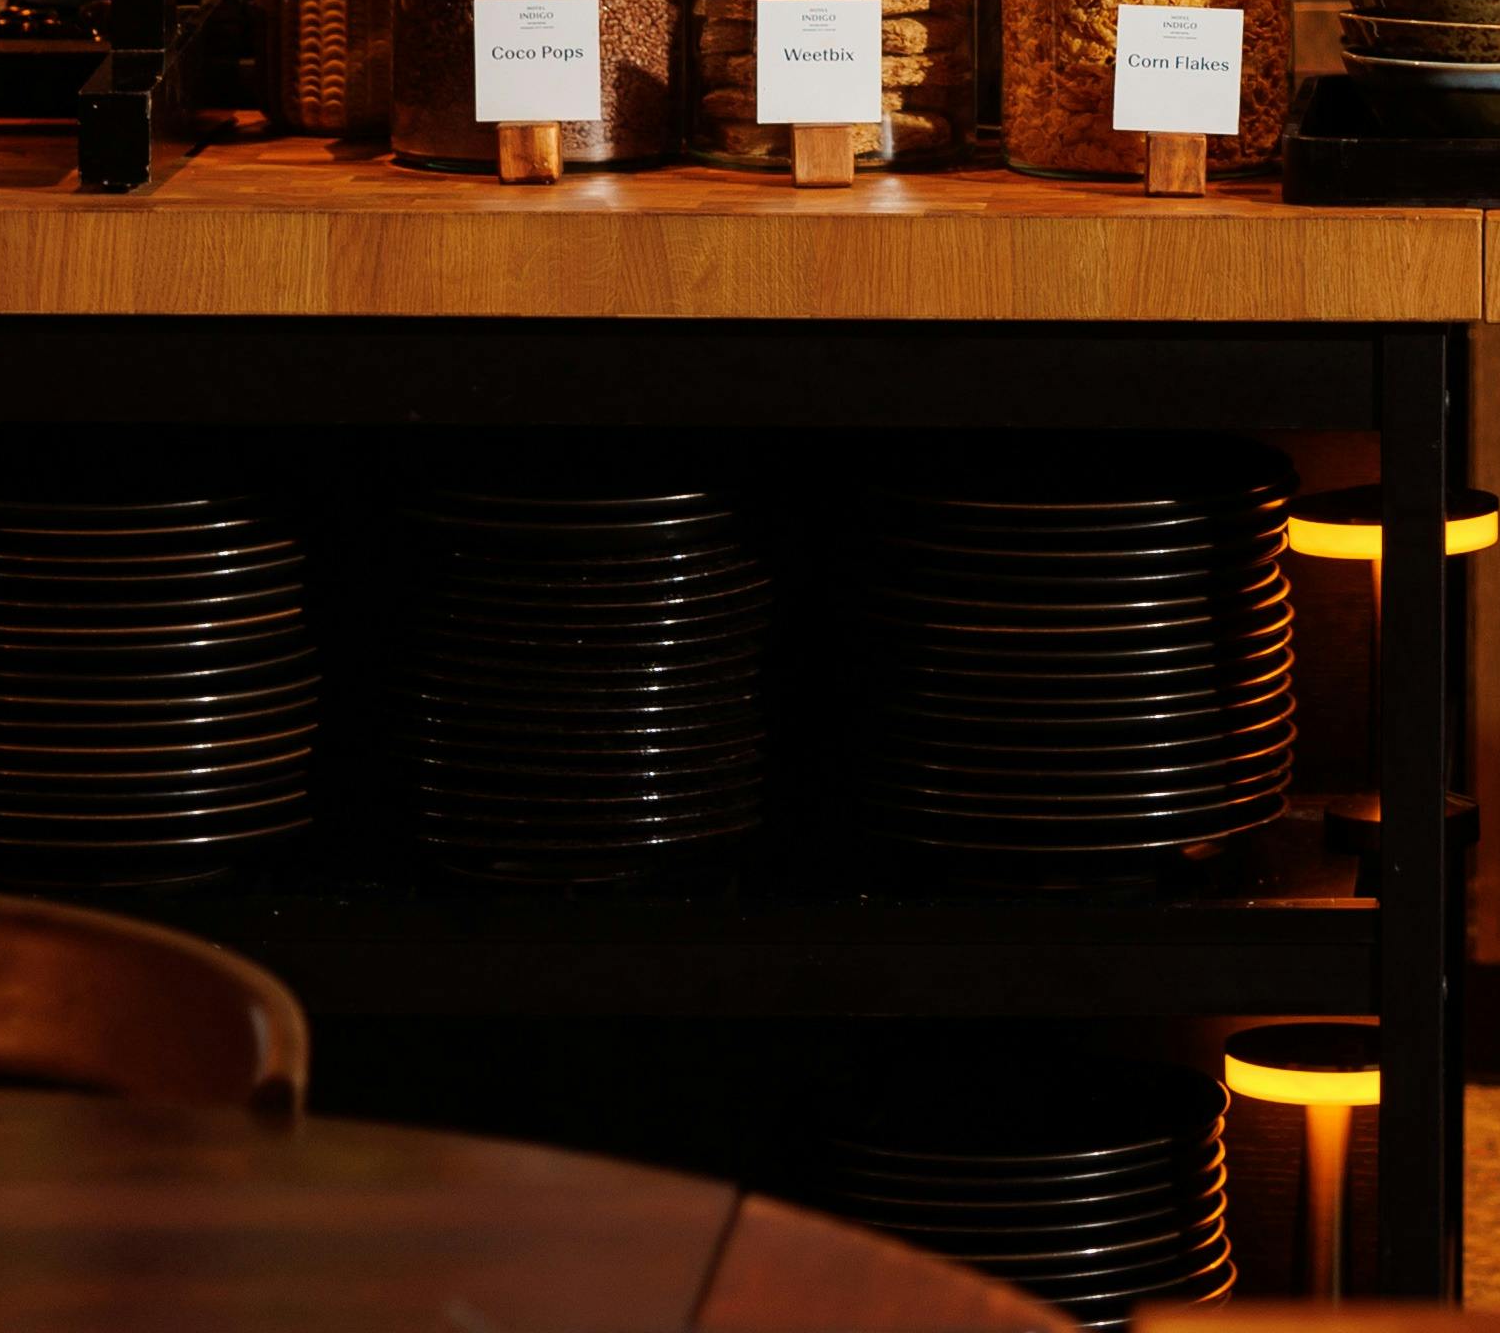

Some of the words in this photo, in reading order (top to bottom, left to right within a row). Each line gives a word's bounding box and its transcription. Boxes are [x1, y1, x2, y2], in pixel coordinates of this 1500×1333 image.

[519, 12, 554, 20] INDIGO
[801, 14, 836, 22] INDIGO
[1163, 21, 1198, 30] INDIGO
[491, 46, 536, 60] Coco
[542, 45, 584, 62] Pops
[784, 47, 854, 62] Weetbix
[1128, 53, 1169, 69] Corn
[1175, 55, 1230, 72] Flakes
